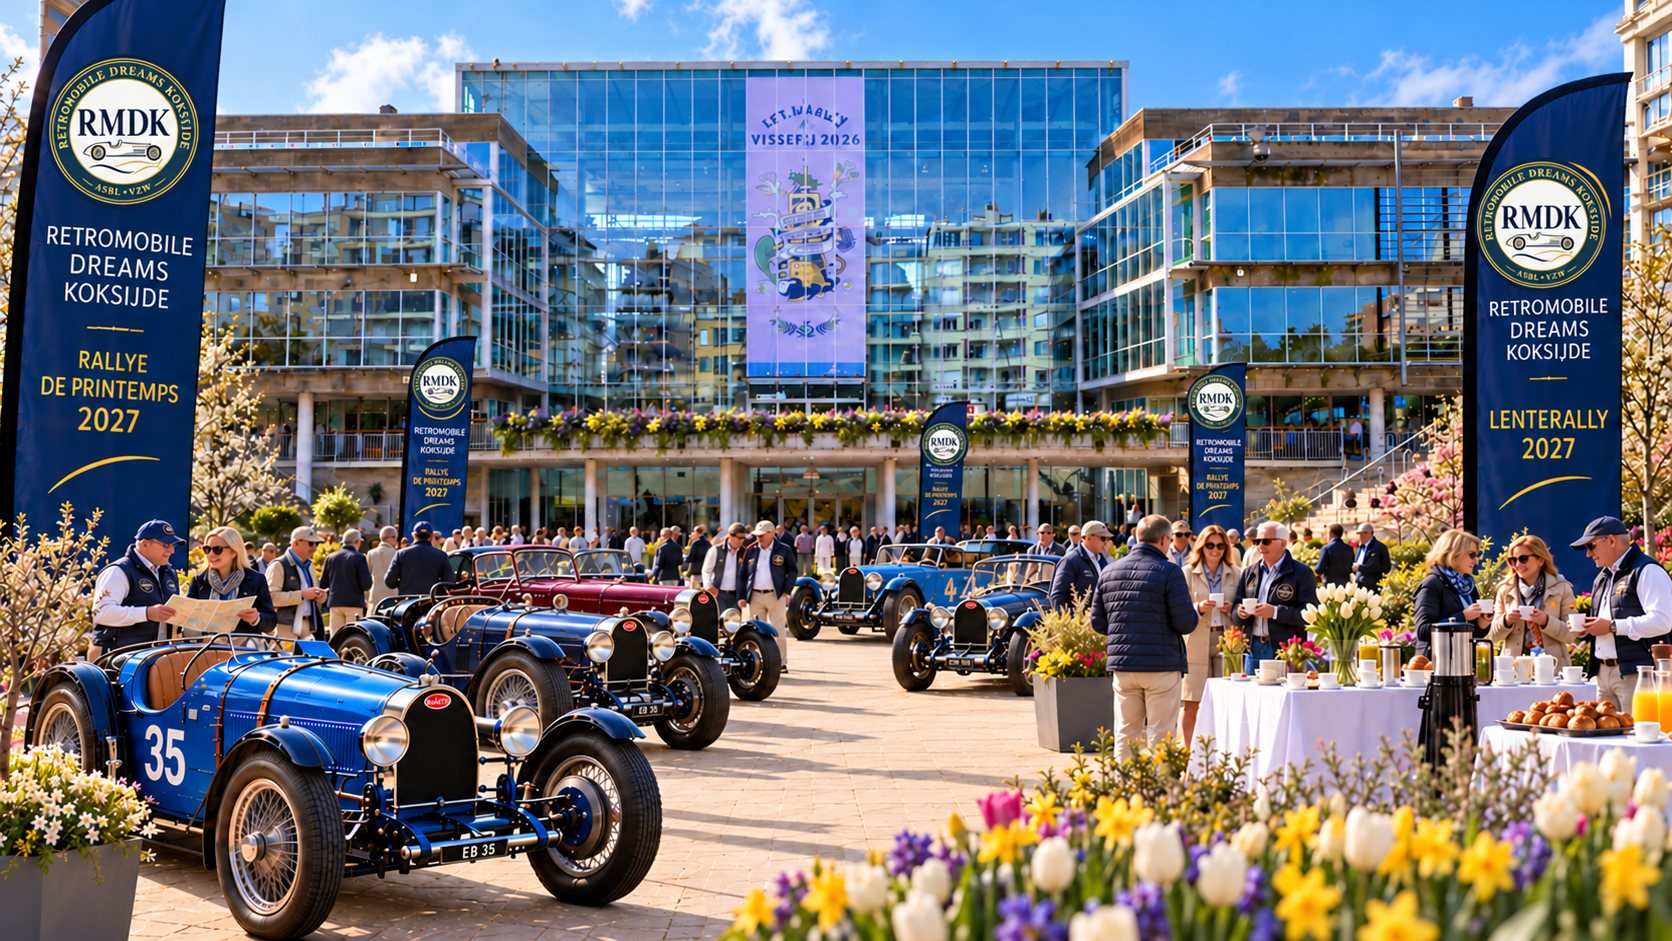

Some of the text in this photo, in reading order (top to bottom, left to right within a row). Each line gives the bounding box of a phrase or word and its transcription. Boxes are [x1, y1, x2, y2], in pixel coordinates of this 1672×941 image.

[57, 70, 106, 150] RETROMOBILE
[109, 66, 165, 88] DREAMS
[78, 109, 170, 136] RMDK
[820, 134, 860, 146] 2026
[1529, 168, 1577, 187] DREAMS
[95, 183, 151, 196] ASBL VZW
[1501, 205, 1581, 229] RMDK
[46, 225, 194, 256] RETROMOBILE
[70, 254, 168, 281] DREAMS
[65, 282, 169, 309] KOKSIJDE
[1490, 298, 1608, 317] RETROMOBILE
[1511, 320, 1589, 339] DREAMS
[79, 350, 148, 373] RALLYE
[1507, 343, 1591, 362] KOKSIJDE
[41, 376, 178, 403] DE PRINTEMPS
[423, 375, 457, 387] RMDK
[1199, 393, 1232, 404] RMDK
[78, 406, 140, 433] 2027
[1490, 409, 1608, 429] LENTERALLY
[931, 438, 957, 446] RMDK
[1522, 437, 1575, 459] 2027
[425, 487, 448, 497] 2027
[1208, 491, 1227, 500] 2027
[144, 724, 186, 786] 35
[462, 843, 495, 859] EB 35
